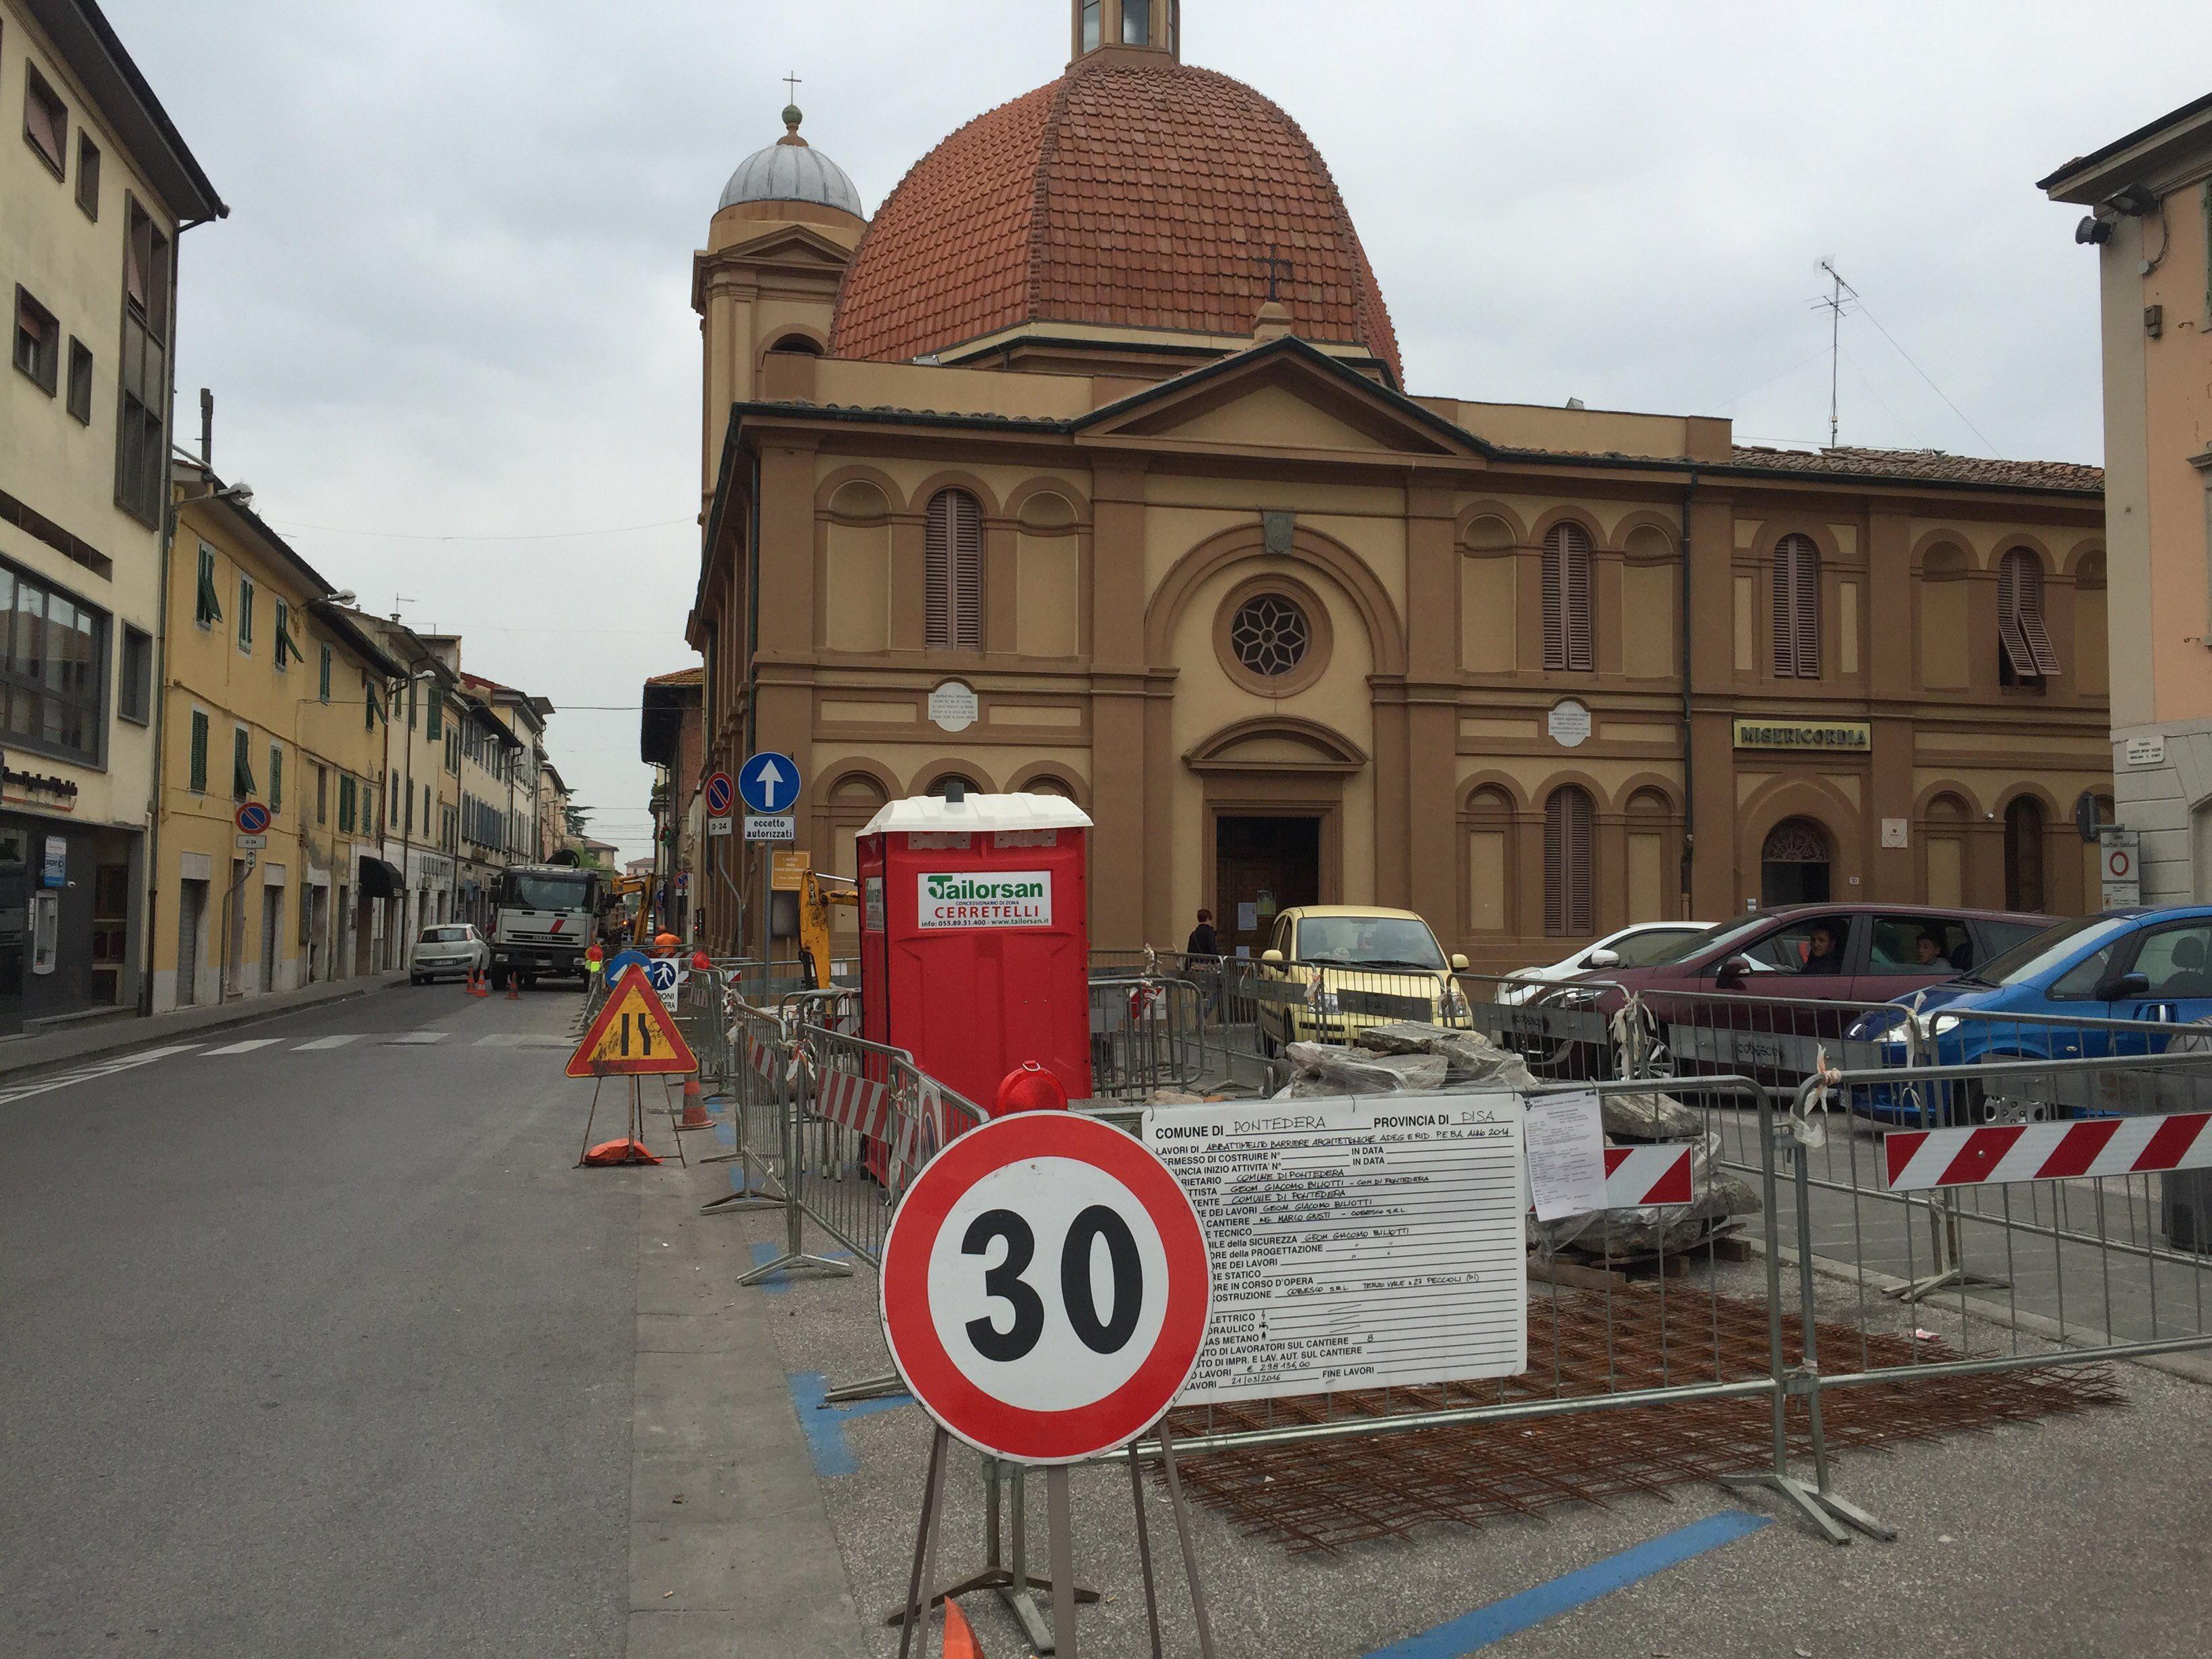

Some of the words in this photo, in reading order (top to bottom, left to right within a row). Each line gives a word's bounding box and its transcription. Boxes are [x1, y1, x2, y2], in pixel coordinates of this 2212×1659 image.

[1740, 726, 1867, 745] MISERICORDIA
[712, 822, 727, 830] 0-24
[754, 819, 785, 827] eccetto
[747, 830, 792, 838] autorizzati
[928, 875, 1043, 900] Tailorsan
[935, 905, 1039, 919] CERRETELLI
[1155, 1126, 1208, 1139] COMUNE
[1212, 1125, 1224, 1136] DI
[1234, 1115, 1326, 1134] PONTEDERA
[1374, 1115, 1435, 1128] PROVINCIA
[1438, 1114, 1449, 1125] DI
[1460, 1110, 1495, 1124] PISA
[1155, 1146, 1189, 1155] LAVORI
[1270, 1139, 1309, 1149] BARRIERE
[1163, 1155, 1205, 1166] ERMESSO
[1208, 1155, 1216, 1163] DI
[1218, 1153, 1269, 1162] COSTRUIRE
[1361, 1147, 1384, 1155] DATA
[1172, 1167, 1202, 1176] UNCIA
[1204, 1166, 1229, 1174] INIZIO
[1363, 1157, 1385, 1165] DATA
[1181, 1176, 1222, 1186] RIETARIO
[1236, 1173, 1273, 1183] COMUNE
[1289, 1169, 1345, 1179] PONTEDERA
[1188, 1187, 1218, 1197] TTISTA
[1264, 1183, 1304, 1191] GIACOMO
[1193, 1198, 1220, 1207] TENTE
[1231, 1194, 1272, 1205] COMUNE
[1292, 1190, 1346, 1200] PONTEDERA
[1209, 1208, 1223, 1217] DEI
[1225, 1207, 1257, 1216] LAVORI
[1295, 1202, 1330, 1210] GIACOMO
[1206, 1218, 1250, 1228] CANTIERE
[1306, 1212, 1331, 1220] GIUSTI
[1214, 1228, 1252, 1237] TECNICO
[1227, 1240, 1247, 1248] della
[1249, 1235, 1298, 1246] SICUREZZA
[1332, 1231, 1369, 1240] GIACOMO
[1229, 1250, 1249, 1258] della
[1251, 1245, 1324, 1256] PROGETTAZIONE
[1246, 1258, 1278, 1267] LAVORI
[1225, 1270, 1261, 1280] STATICO
[961, 1204, 1143, 1362] 30
[1231, 1282, 1240, 1290] IN
[1242, 1279, 1273, 1289] CORSO
[1275, 1277, 1313, 1288] D'OPERA
[1214, 1290, 1272, 1302] OSTRUZIONE
[1210, 1313, 1256, 1324] LETTRICO
[1208, 1324, 1254, 1335] DRAULICO
[1219, 1347, 1228, 1355] DI
[1230, 1343, 1285, 1355] LAVORATORI
[1288, 1341, 1304, 1349] SUL
[1307, 1337, 1349, 1348] CANTIERE
[1367, 1334, 1374, 1343] 8
[1223, 1334, 1259, 1345] METANO
[1215, 1358, 1224, 1367] DI
[1225, 1356, 1250, 1366] IMPR.
[1252, 1355, 1258, 1364] E
[1260, 1354, 1279, 1363] LAV.
[1280, 1353, 1299, 1361] AUT.
[1301, 1351, 1318, 1359] SUL
[1319, 1347, 1362, 1357] CANTIERE
[1200, 1368, 1231, 1378] LAVORI
[1322, 1368, 1341, 1378] FINE
[1343, 1366, 1374, 1376] LAVORI
